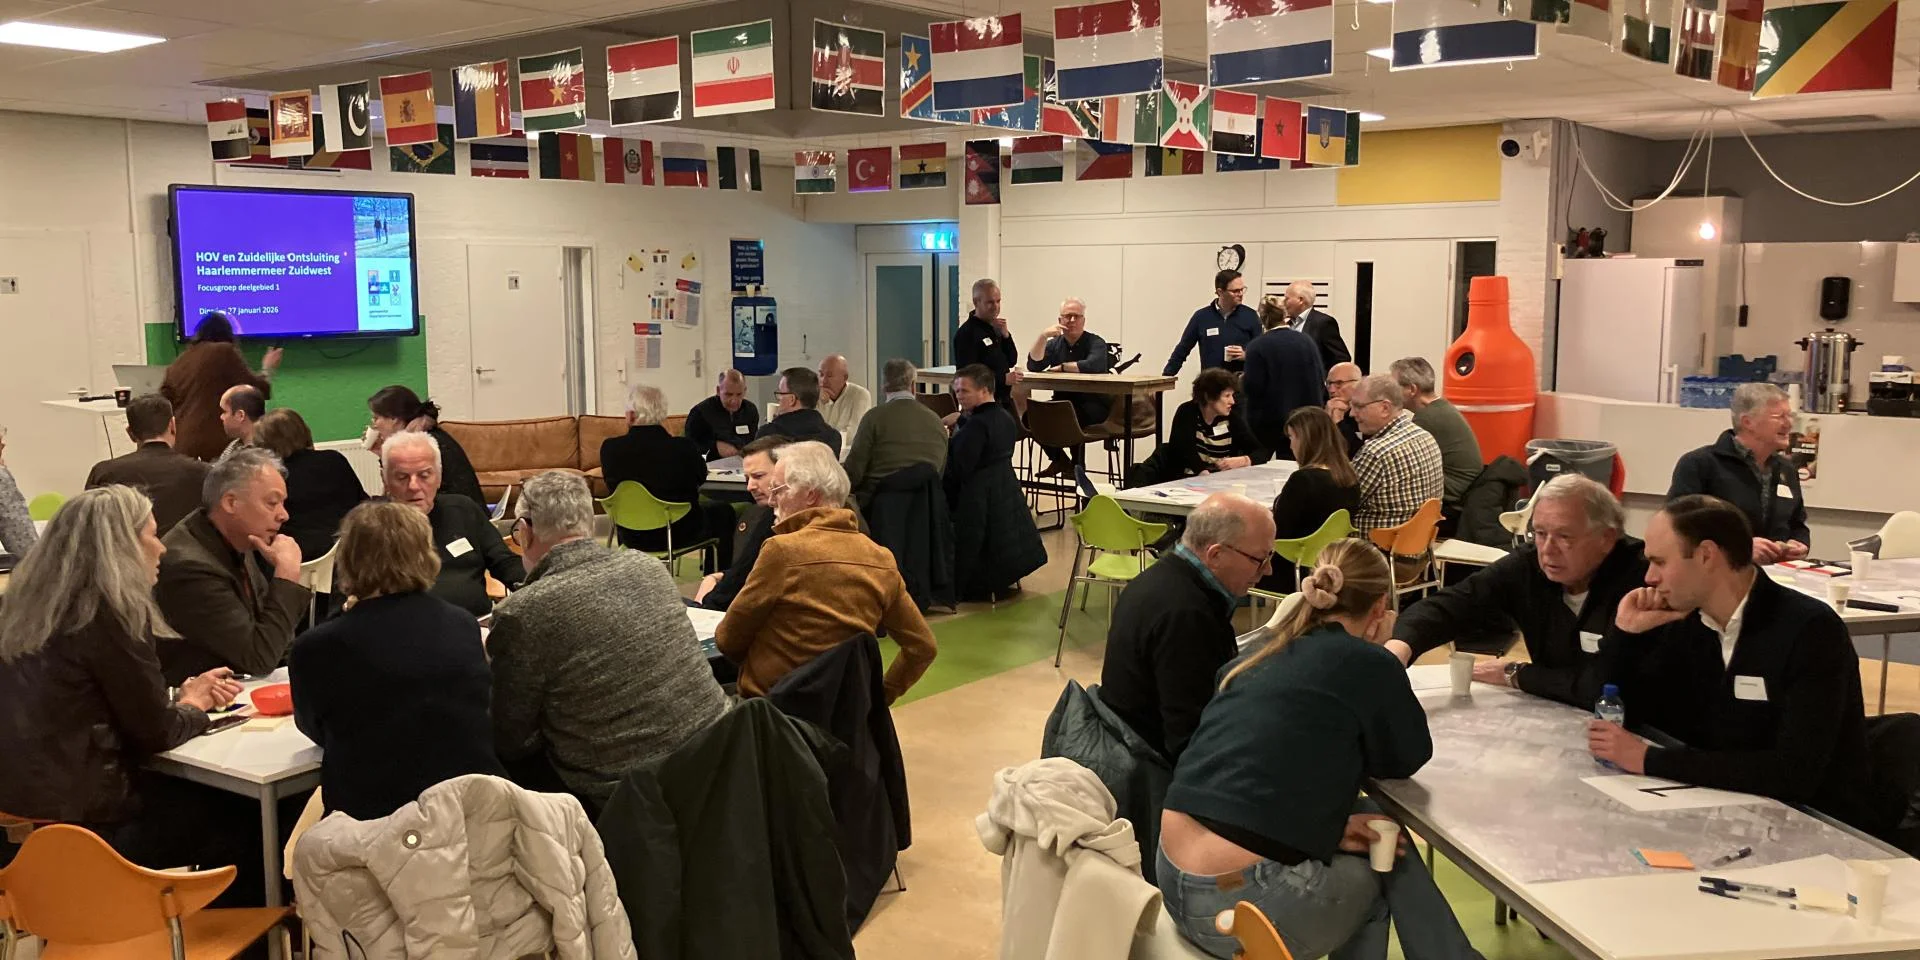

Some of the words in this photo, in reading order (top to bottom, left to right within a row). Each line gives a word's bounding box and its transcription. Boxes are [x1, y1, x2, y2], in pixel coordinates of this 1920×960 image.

[196, 252, 220, 262] HOV
[223, 254, 236, 262] en
[238, 252, 285, 263] Zuidelijke
[287, 253, 340, 264] Ontsluiting
[197, 266, 286, 275] Haarlemmermeer
[288, 266, 332, 275] Zuidwest
[198, 284, 236, 292] Focusgroep
[238, 284, 274, 292] deelgebied
[238, 306, 261, 315] januari
[263, 306, 279, 314] 2026
